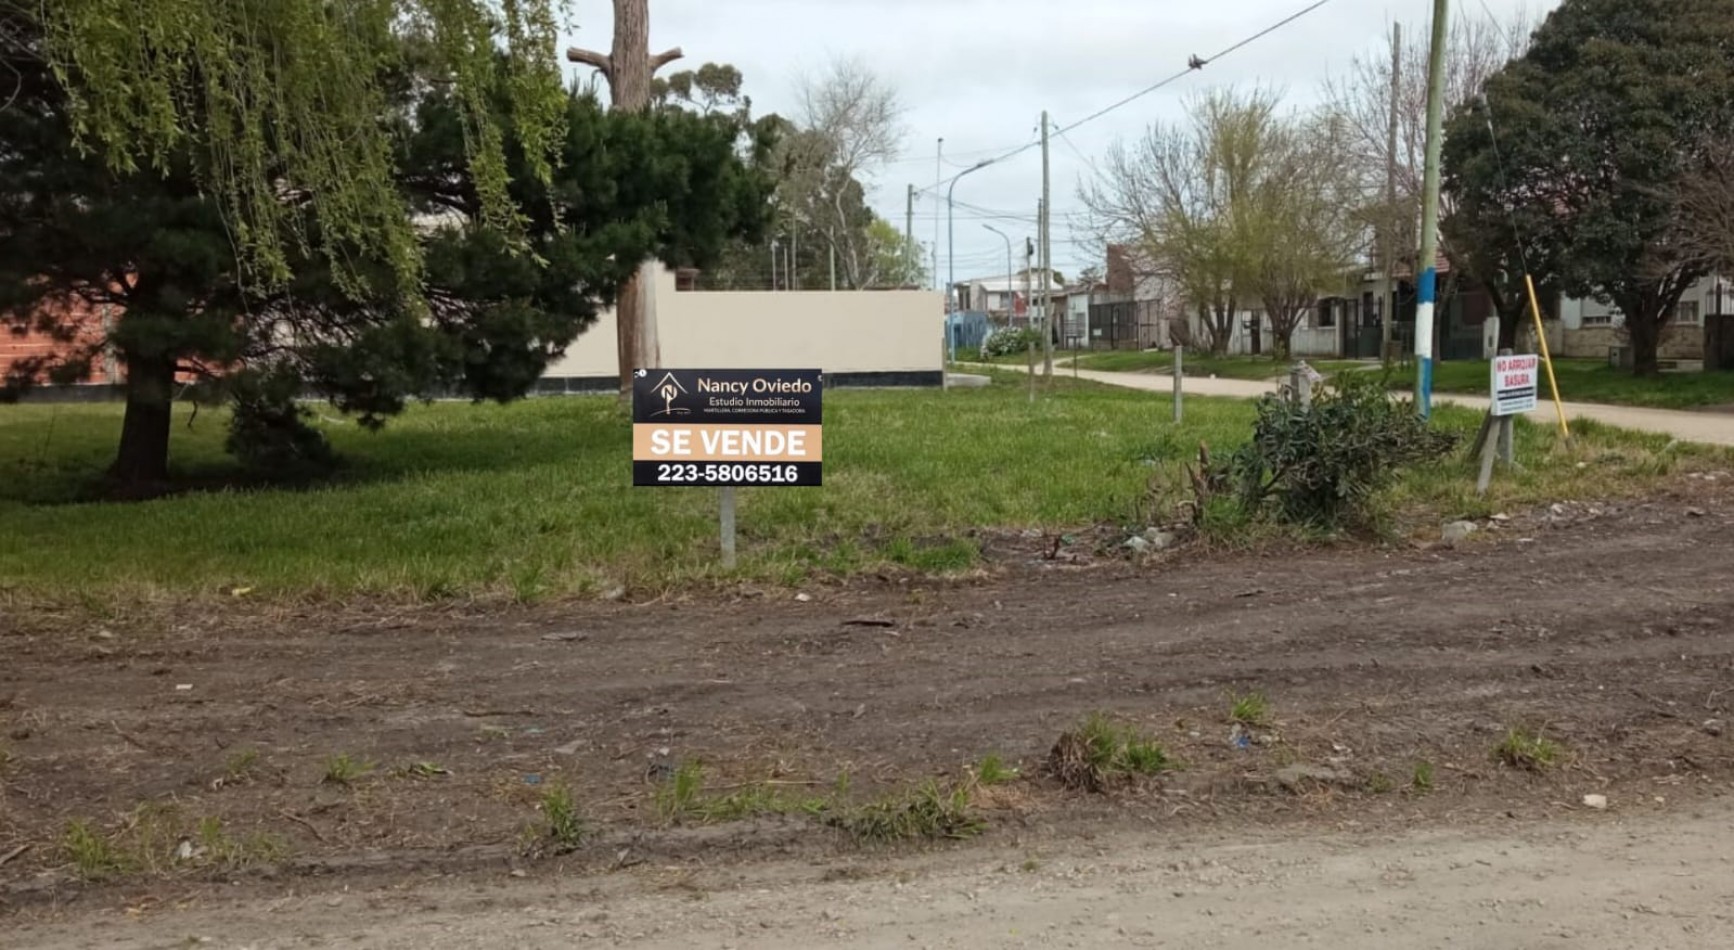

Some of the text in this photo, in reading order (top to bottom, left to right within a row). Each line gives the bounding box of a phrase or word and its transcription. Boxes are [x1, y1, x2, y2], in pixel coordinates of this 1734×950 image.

[1496, 360, 1507, 372] NO
[697, 378, 812, 395] Nancy Oviedo
[1504, 373, 1529, 387] BASURA
[709, 397, 800, 407] Estudio Inmobiliario
[651, 429, 806, 456] SE VENDE
[657, 464, 798, 482] 223-5806516
